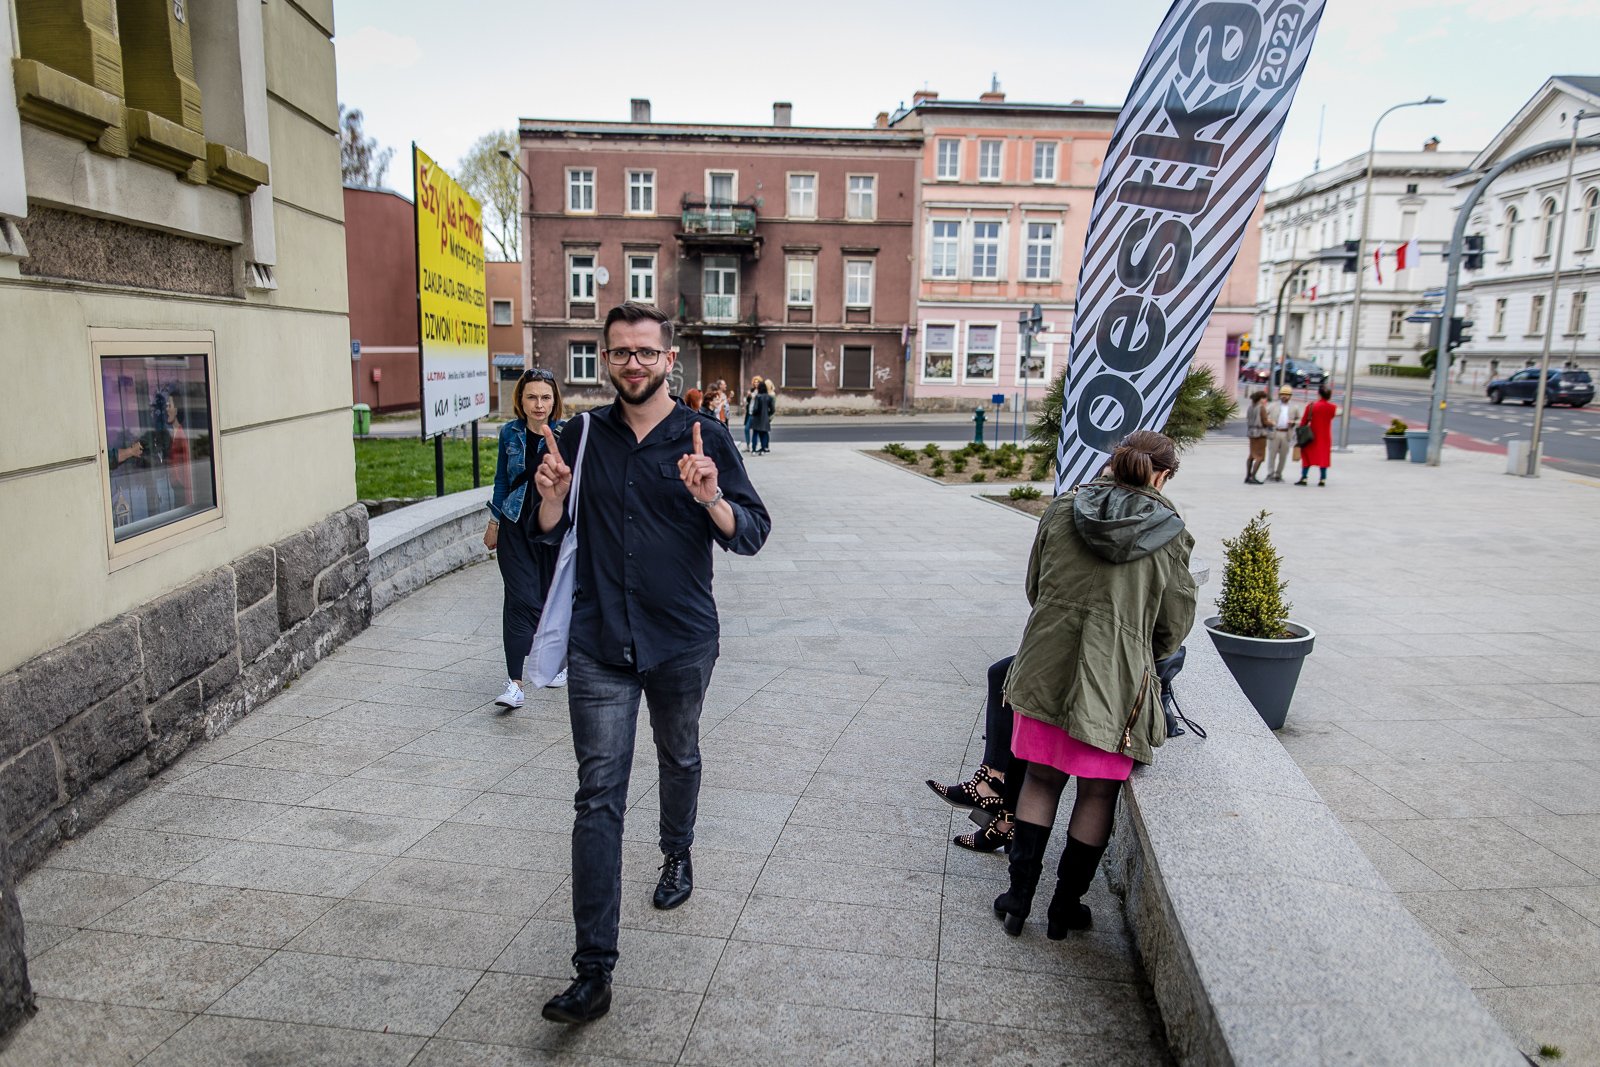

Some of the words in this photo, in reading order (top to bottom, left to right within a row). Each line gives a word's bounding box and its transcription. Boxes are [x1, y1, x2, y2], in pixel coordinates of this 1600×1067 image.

[1260, 13, 1300, 83] 2022
[423, 268, 442, 294] ZAKUP
[427, 371, 446, 382] ULTIMA
